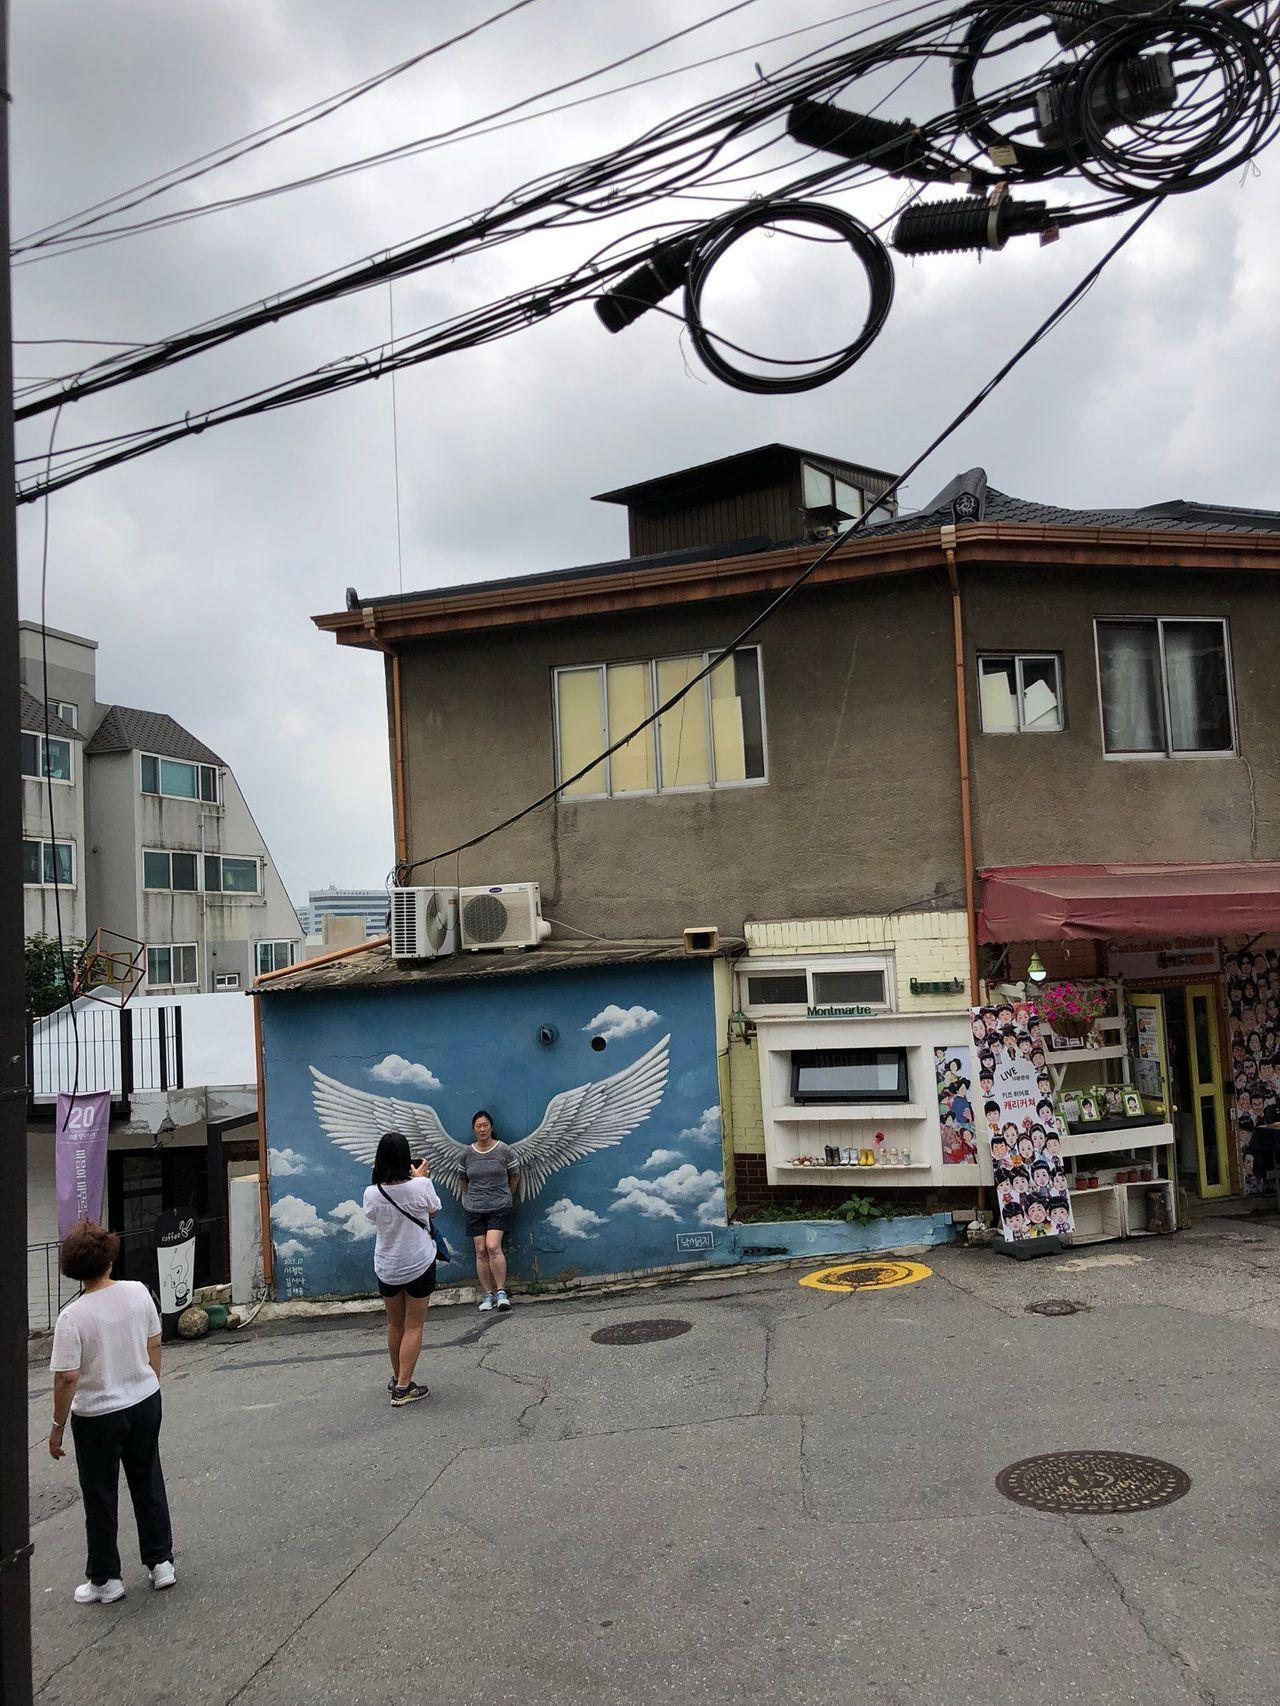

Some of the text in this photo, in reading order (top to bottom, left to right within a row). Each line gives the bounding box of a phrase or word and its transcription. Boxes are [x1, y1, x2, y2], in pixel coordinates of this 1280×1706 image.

[807, 1005, 871, 1016] Montmartre
[1000, 1067, 1017, 1081] LIVE
[69, 1106, 94, 1128] 20
